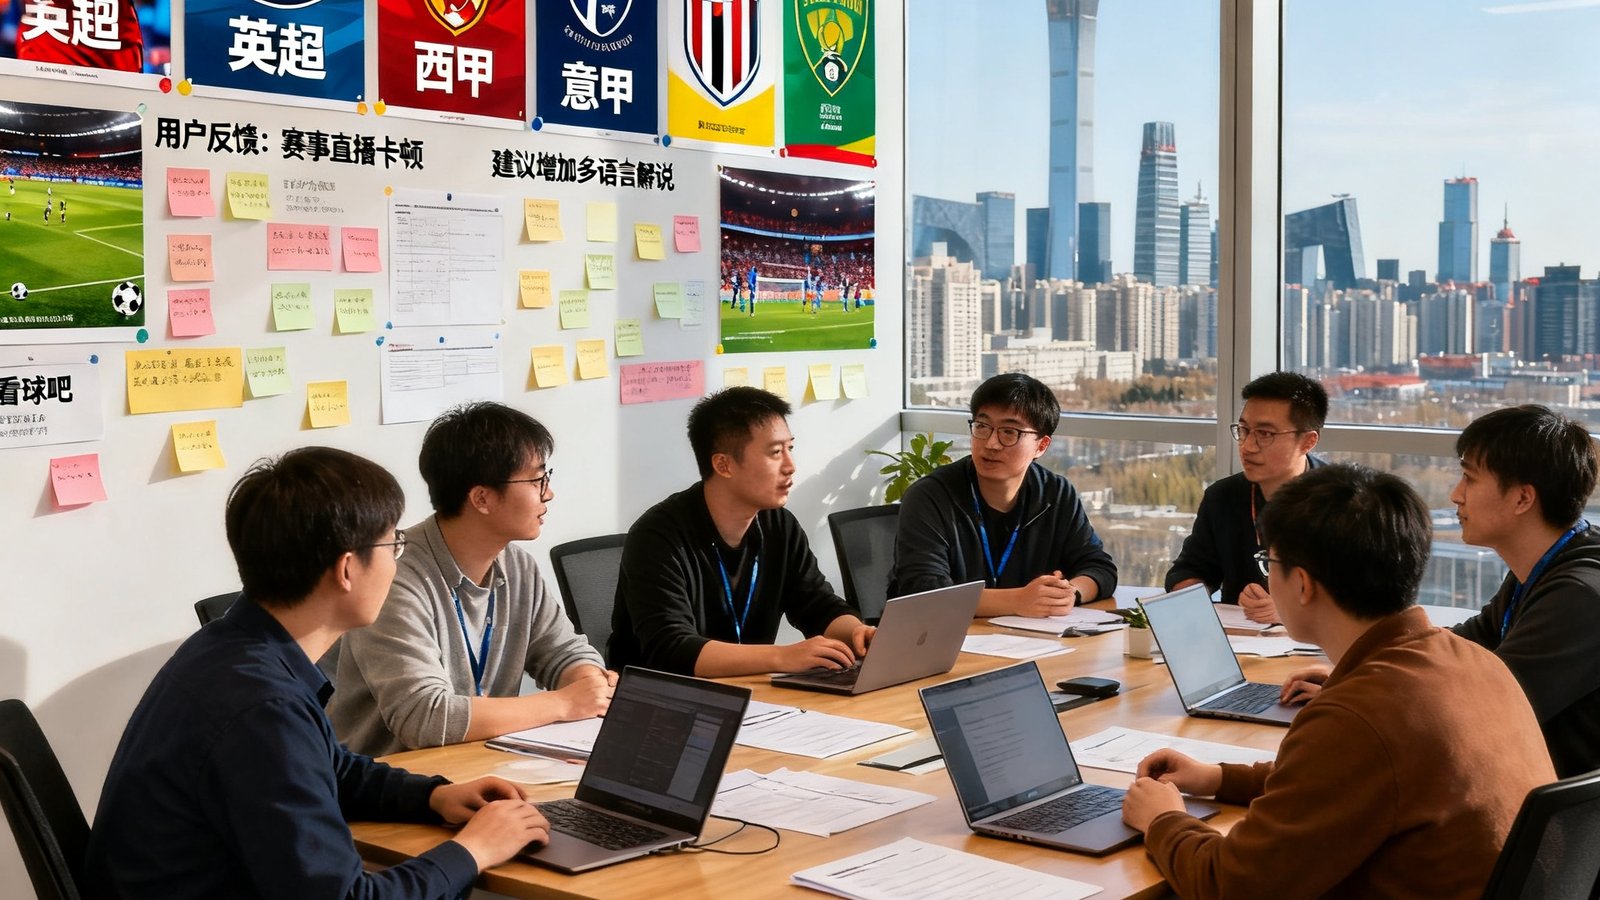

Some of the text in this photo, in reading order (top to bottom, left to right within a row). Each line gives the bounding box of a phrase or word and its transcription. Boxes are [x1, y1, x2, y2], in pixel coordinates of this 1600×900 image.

[21, 0, 122, 50] 英超
[228, 15, 327, 80] 英超
[414, 40, 493, 99] 西甲
[560, 60, 633, 115] 意甲
